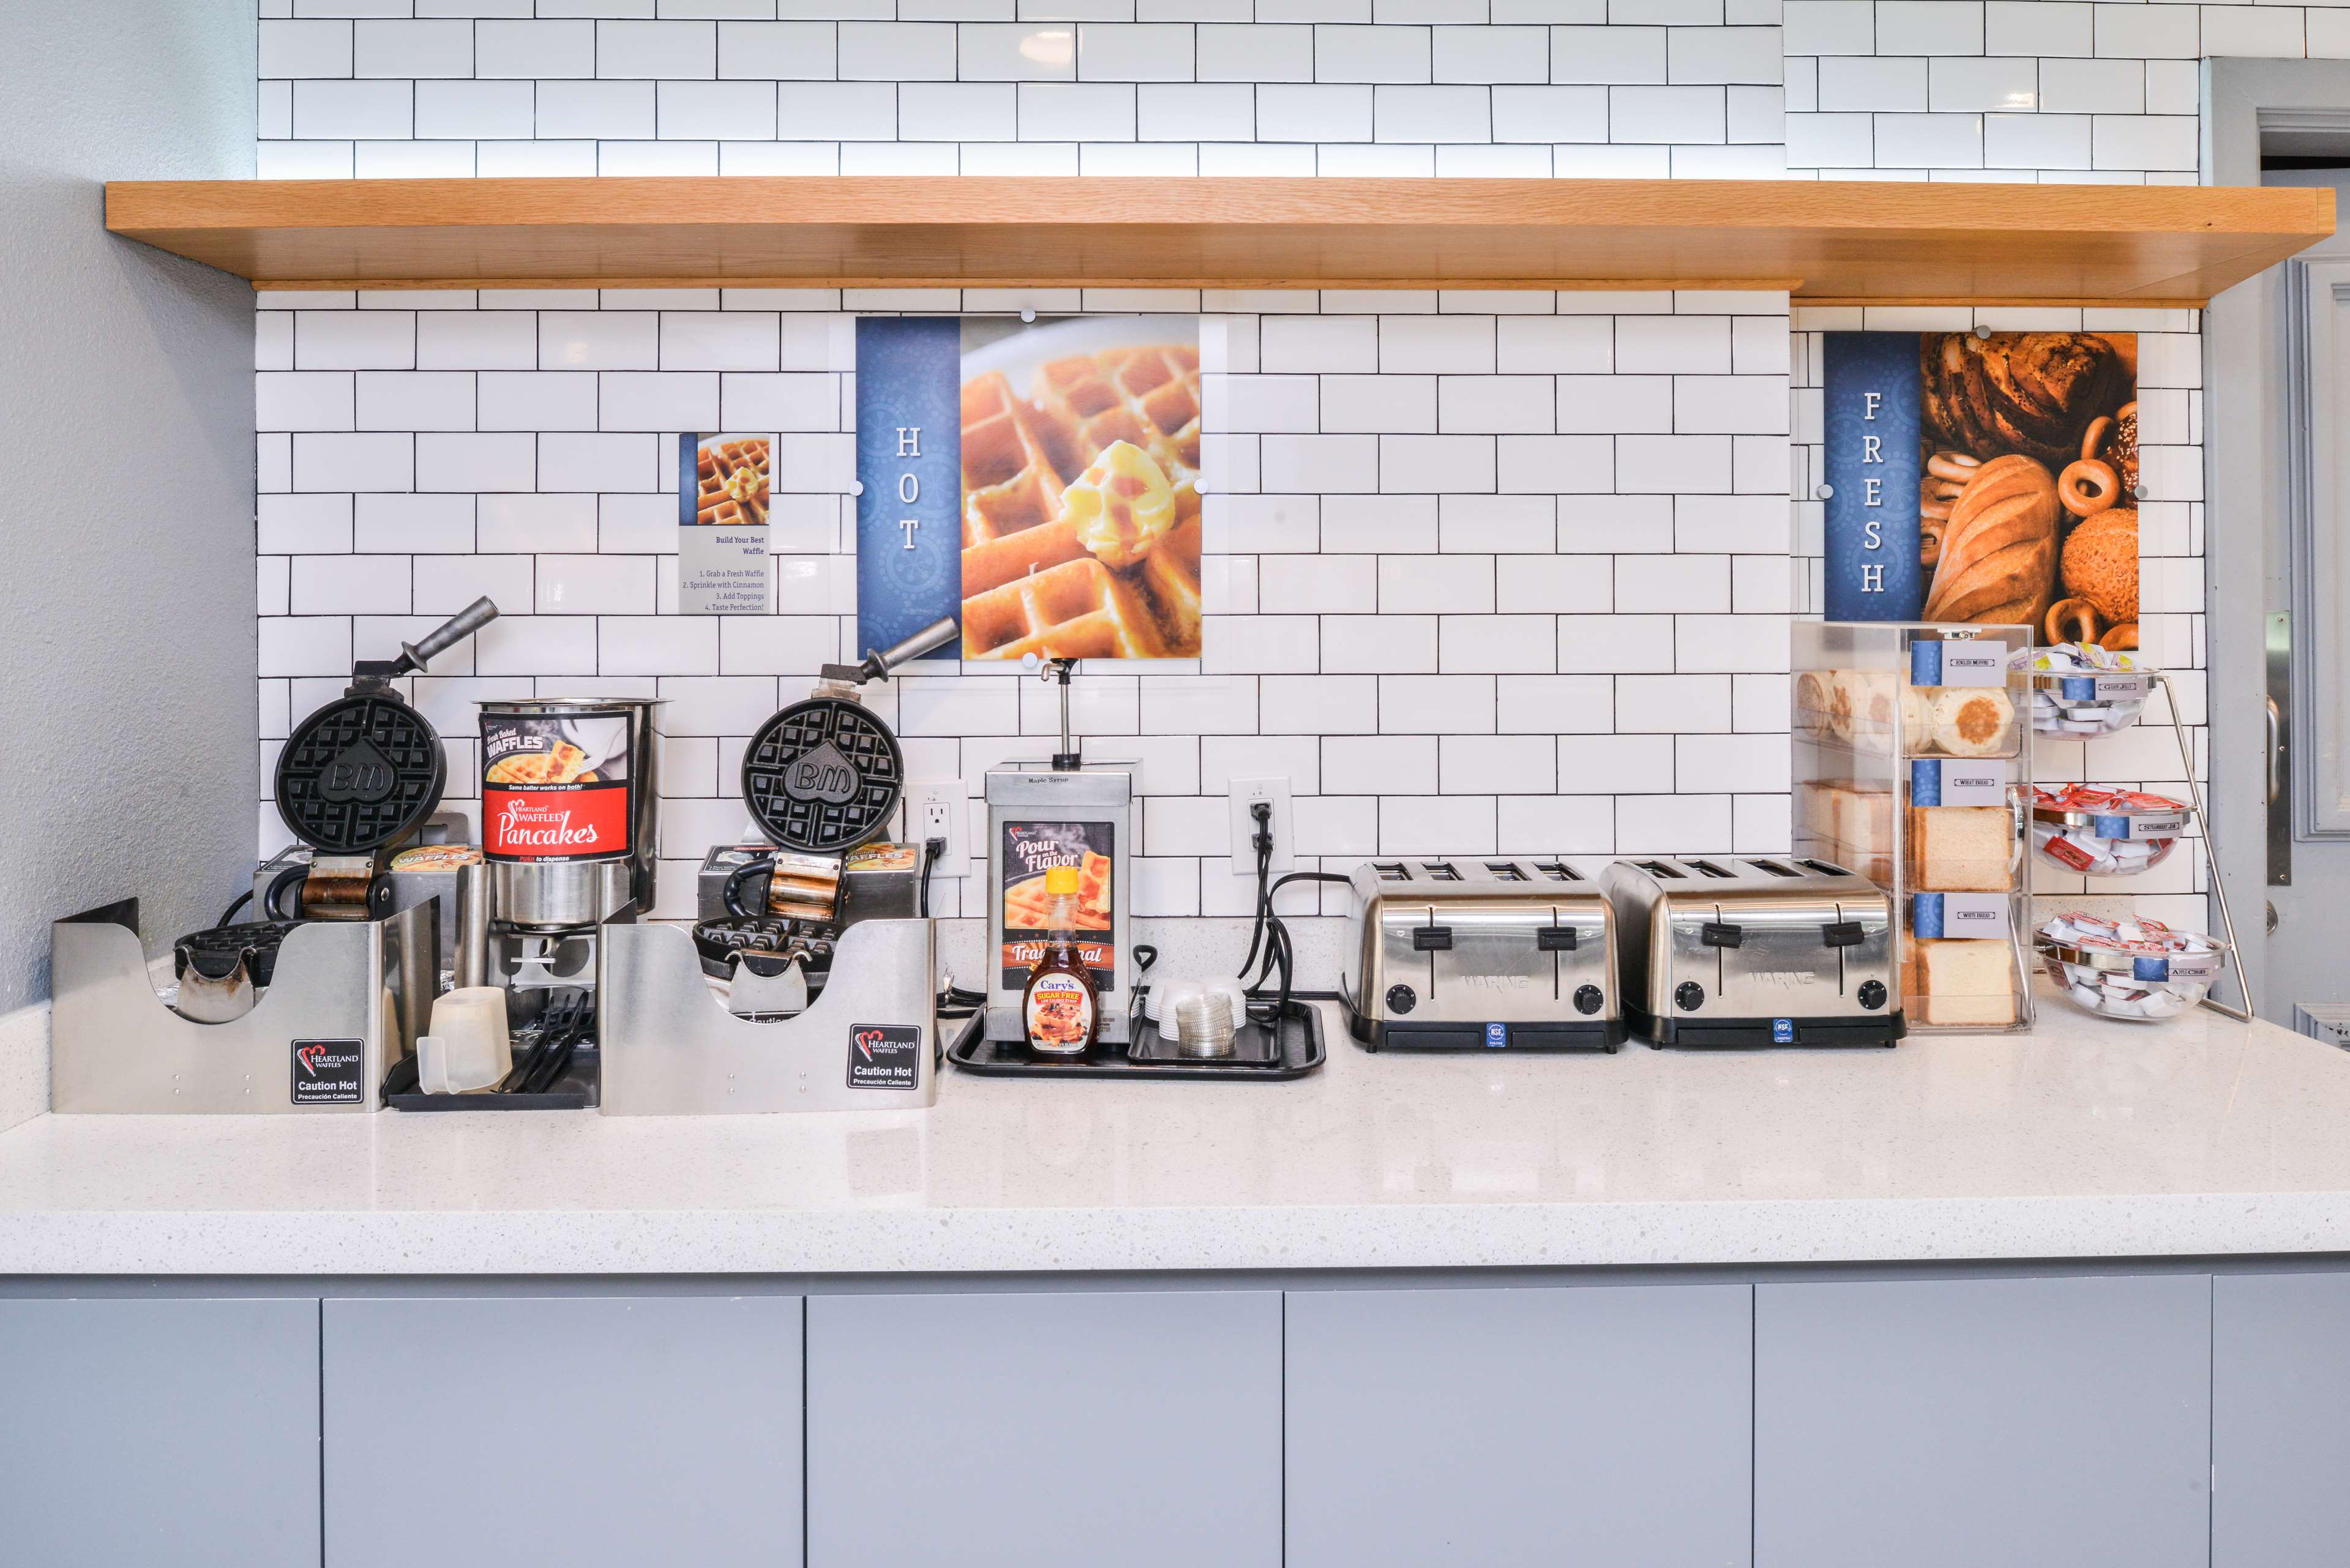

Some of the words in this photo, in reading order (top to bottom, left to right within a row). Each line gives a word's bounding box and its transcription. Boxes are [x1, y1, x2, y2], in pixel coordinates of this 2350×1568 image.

[896, 427, 921, 549] HOT
[1861, 392, 1884, 592] FRESH
[690, 581, 716, 589] Sprinkle
[737, 592, 765, 601] Toppings
[499, 727, 517, 739] Baked
[487, 736, 544, 758] WAFFLES
[796, 762, 851, 794] BM
[519, 813, 564, 822] WAFFLED
[497, 810, 599, 847] Pancakes
[1016, 840, 1060, 859] Pour
[398, 854, 471, 864] WAFFLES
[850, 852, 904, 861] AFFLES
[1025, 853, 1079, 872] Flavor
[1040, 979, 1074, 992] Cary's
[1061, 991, 1080, 1000] FREE
[868, 1040, 915, 1049] HEARTLAND
[854, 1066, 891, 1076] Caution
[894, 1067, 912, 1077] Hot
[298, 1081, 336, 1091] Caution
[339, 1081, 357, 1091] Hot
